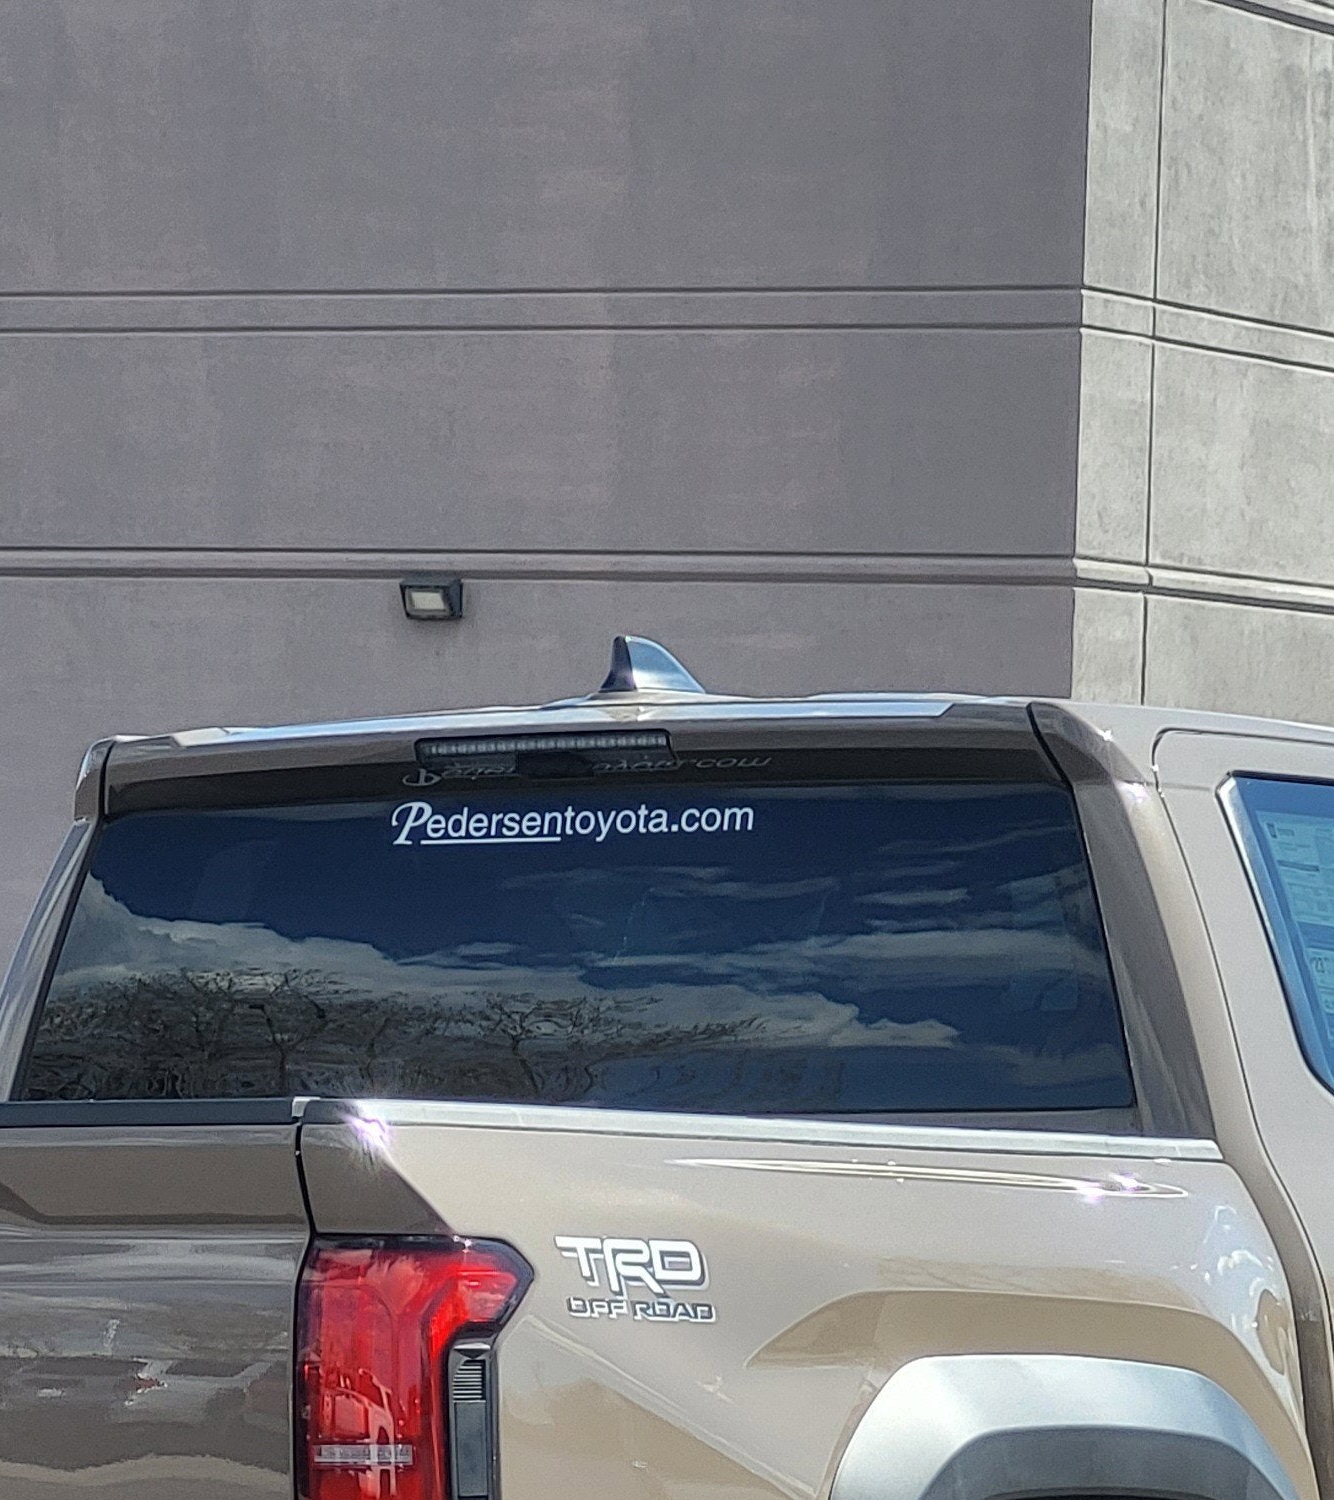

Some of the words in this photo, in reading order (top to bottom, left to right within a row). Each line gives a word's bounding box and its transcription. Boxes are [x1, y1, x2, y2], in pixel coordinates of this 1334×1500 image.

[392, 801, 755, 845] Pedersentoyota.com
[554, 1235, 708, 1296] TRD
[567, 1297, 628, 1319] OFF
[631, 1300, 717, 1323] ROAD
